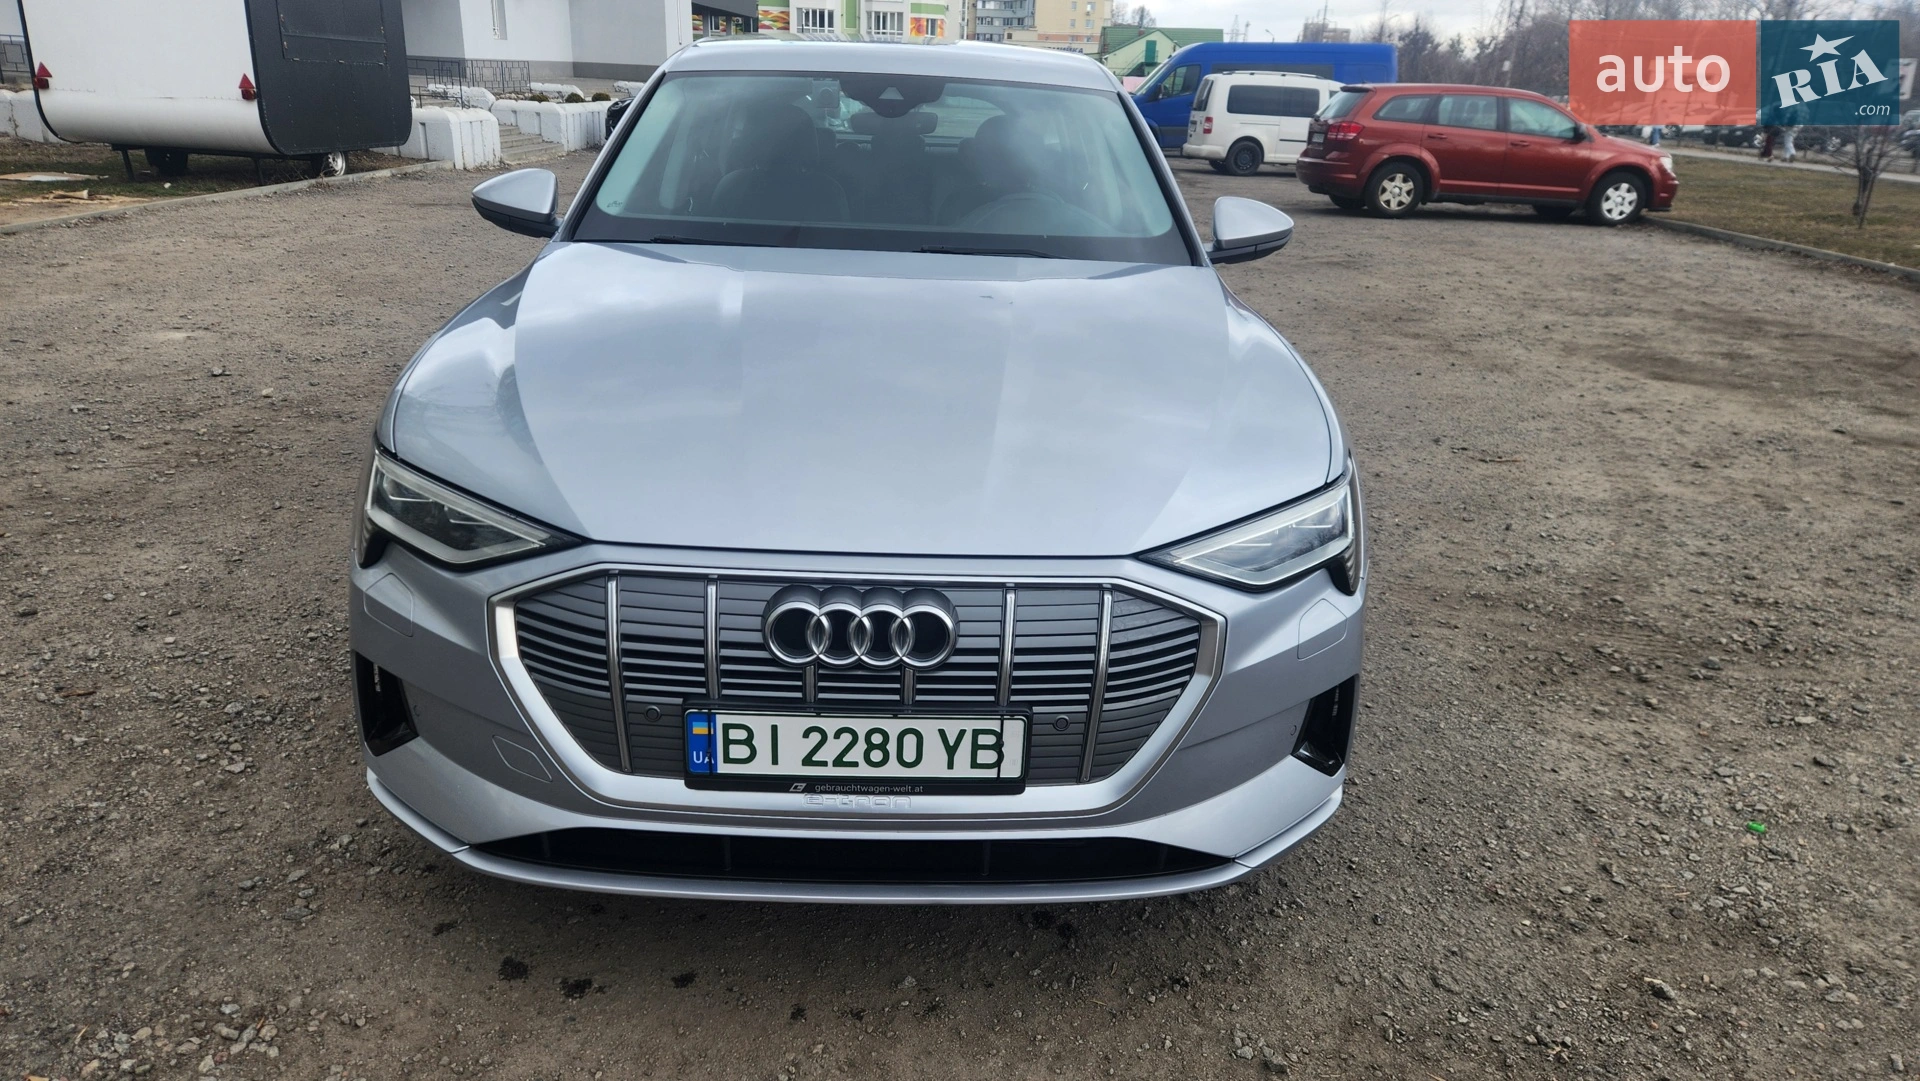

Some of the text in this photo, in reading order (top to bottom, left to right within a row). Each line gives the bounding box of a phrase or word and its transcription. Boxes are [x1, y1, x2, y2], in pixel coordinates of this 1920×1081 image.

[722, 723, 1005, 770] BI 2280 YB
[814, 783, 924, 793] gebrauchtwagen-welt.at
[803, 792, 912, 809] e-tron
